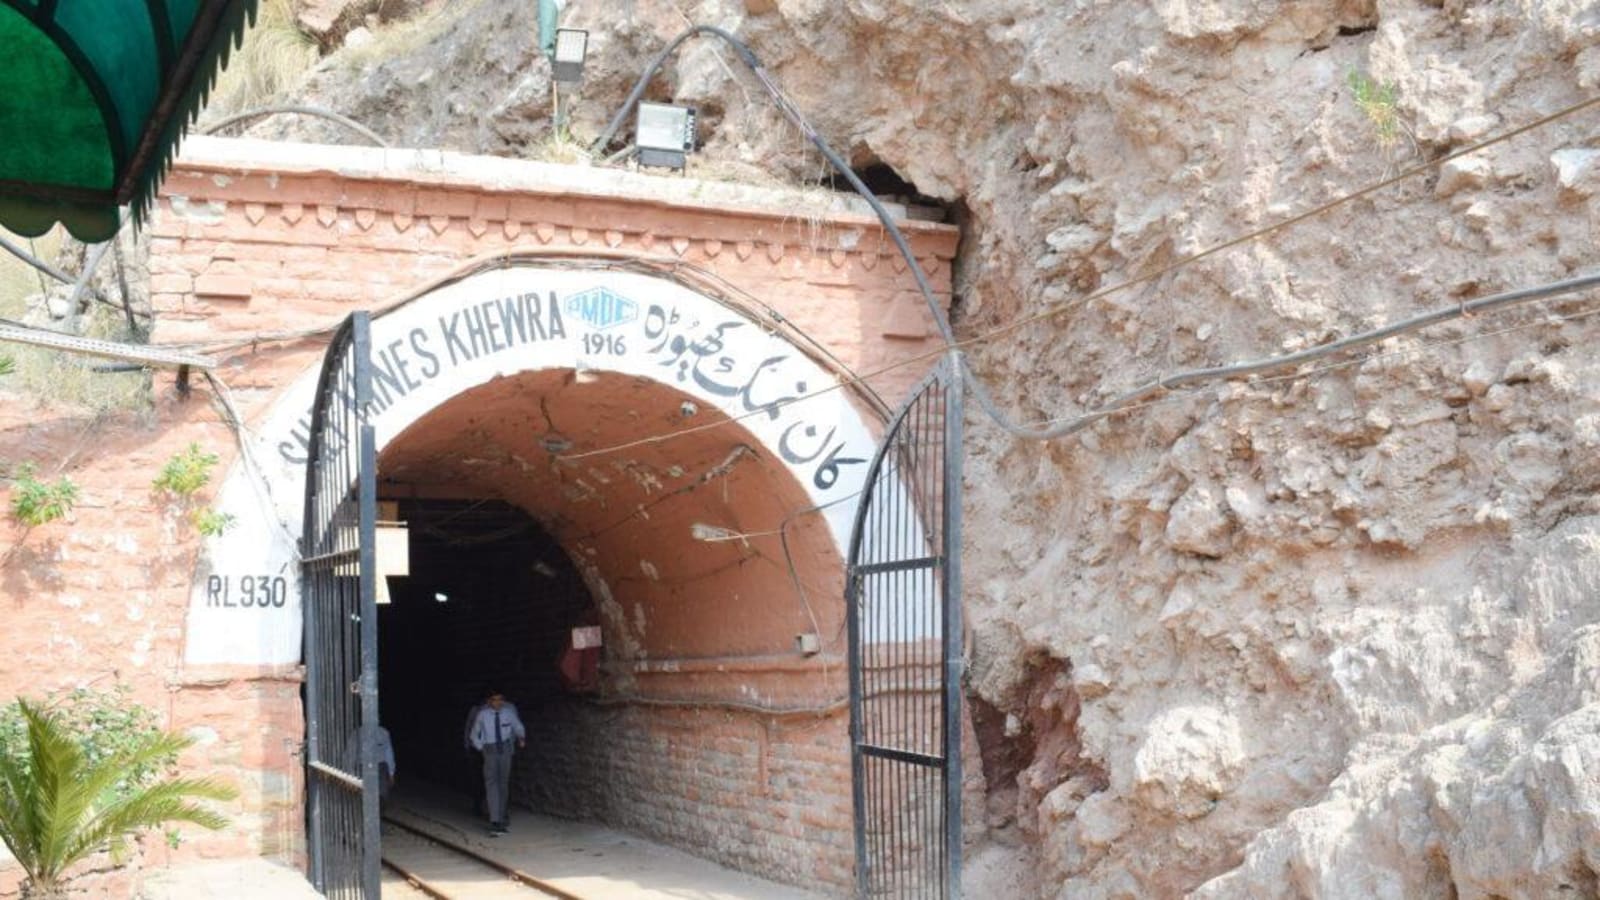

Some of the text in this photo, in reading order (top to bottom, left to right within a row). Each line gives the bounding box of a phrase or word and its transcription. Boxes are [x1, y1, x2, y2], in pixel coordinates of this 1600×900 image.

[438, 291, 567, 367] KHEWRA
[581, 333, 627, 356] 1916
[778, 421, 868, 491] کان
